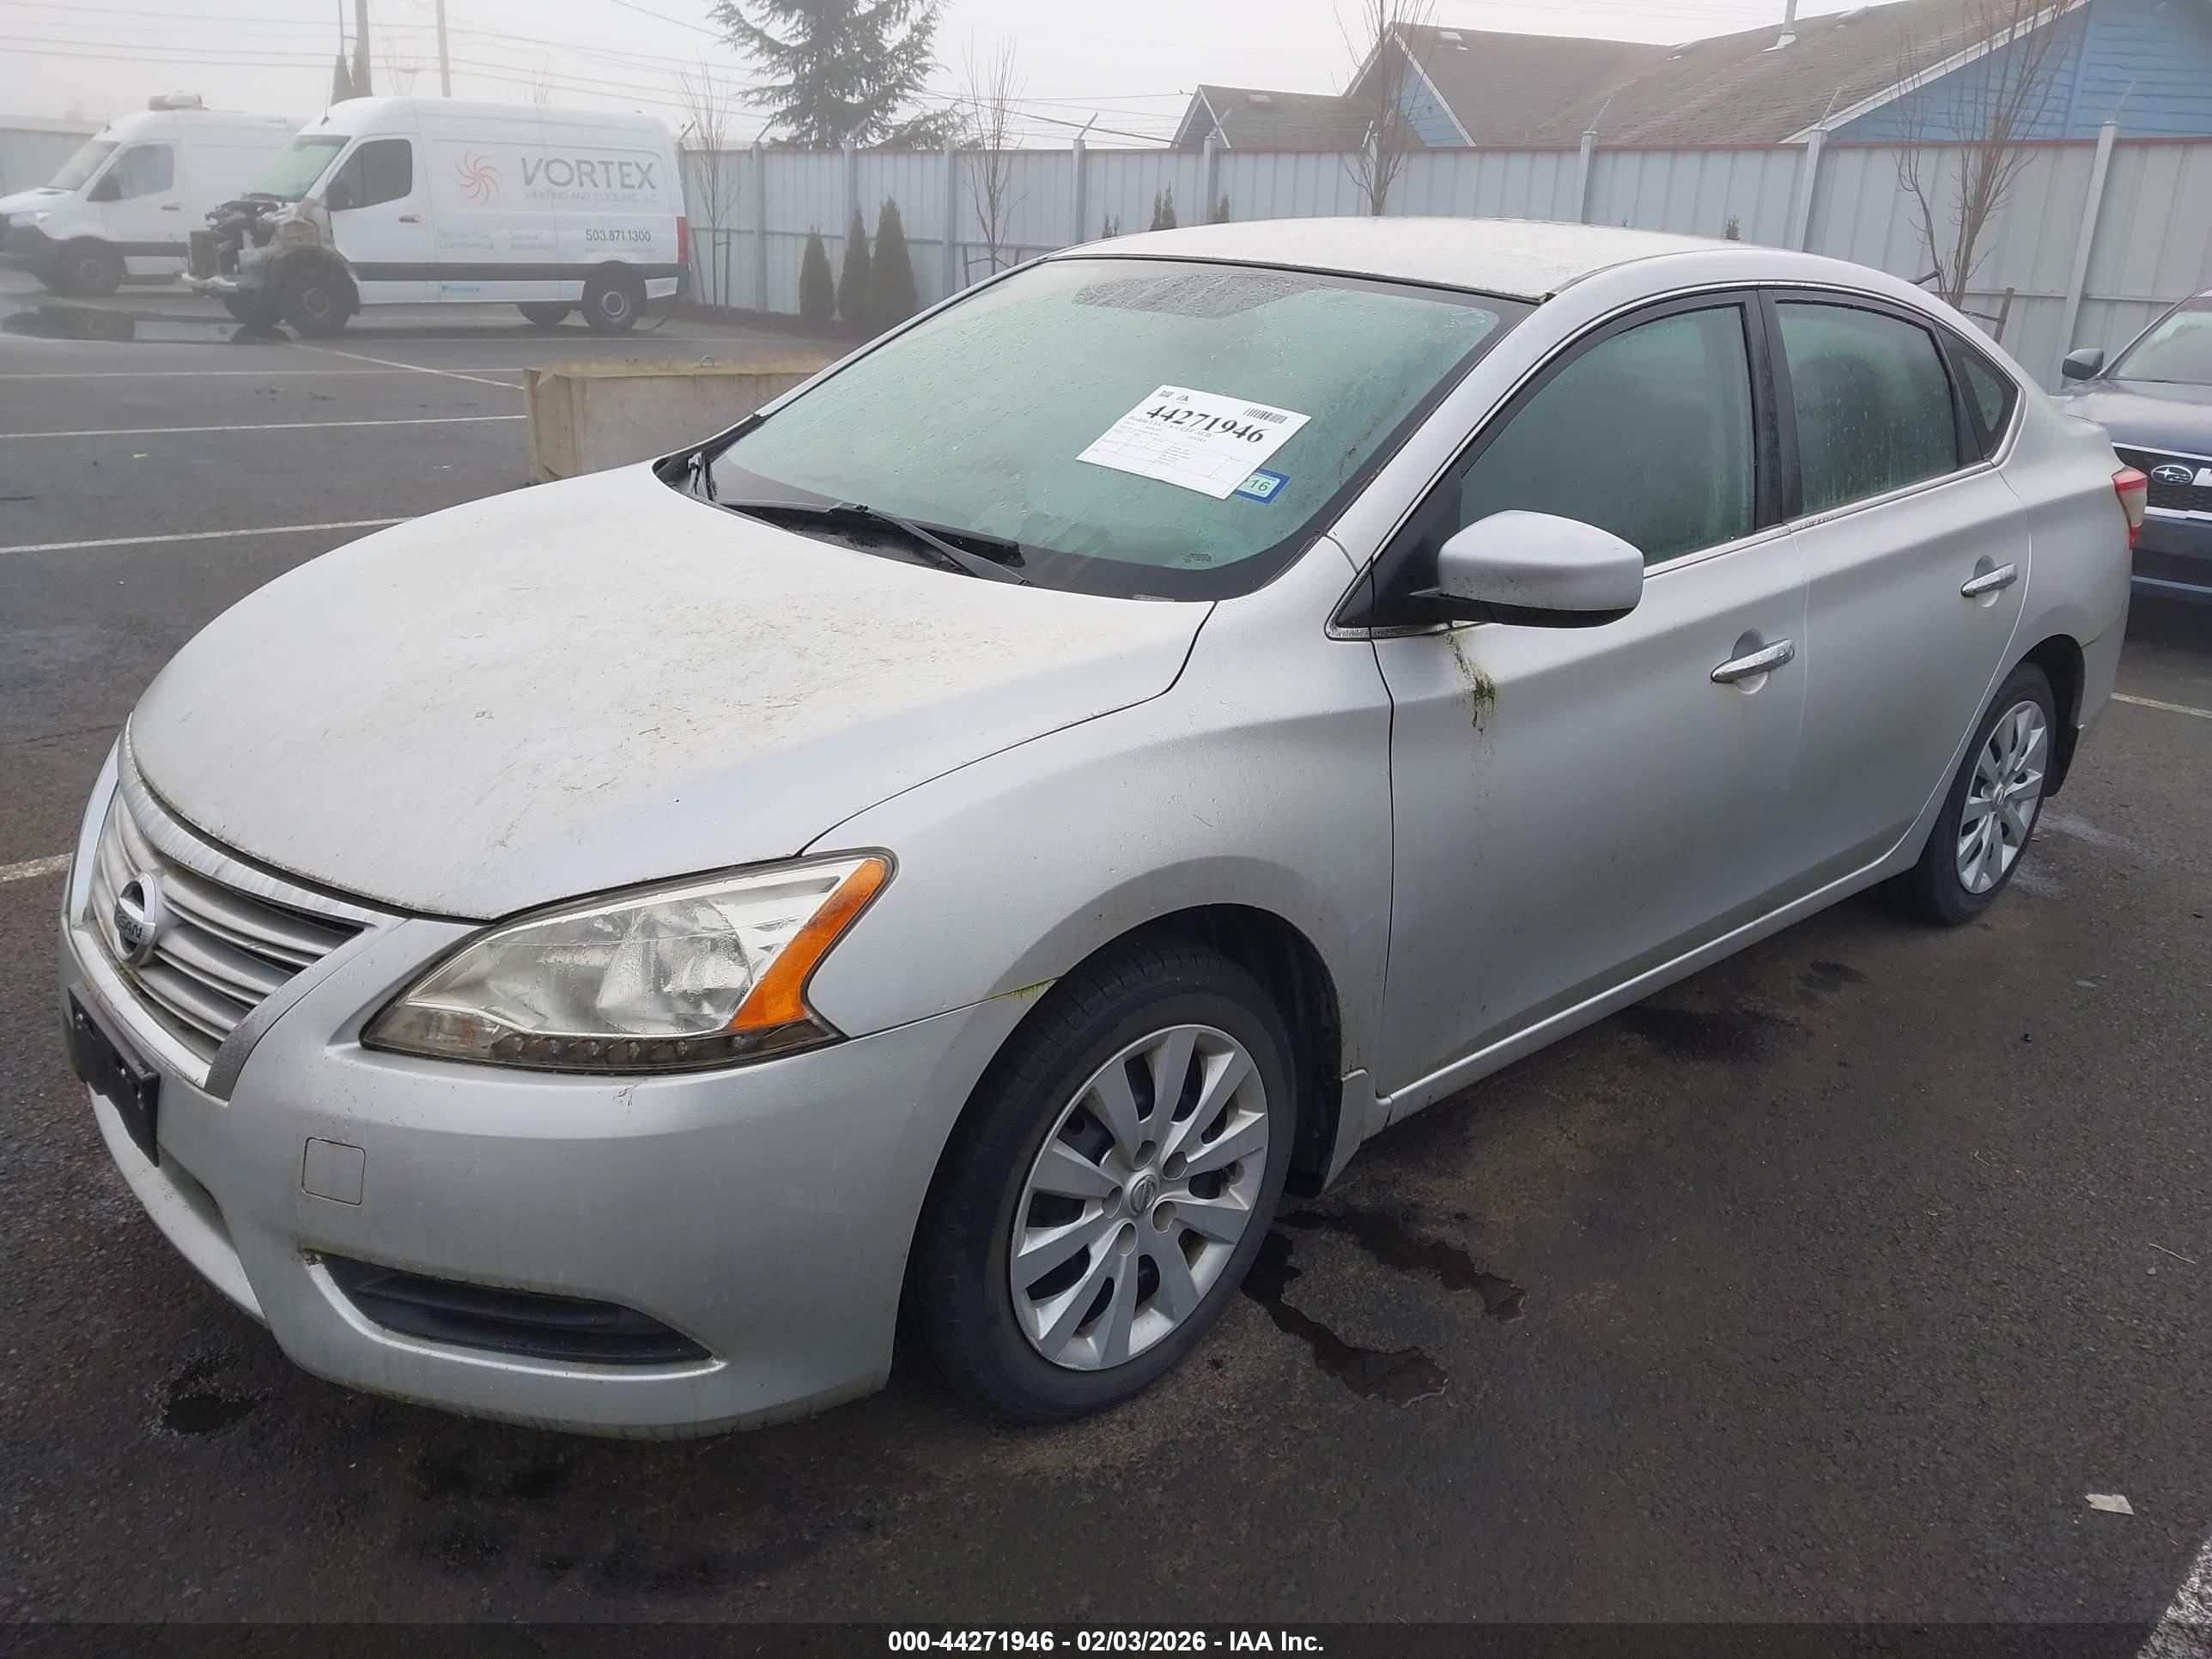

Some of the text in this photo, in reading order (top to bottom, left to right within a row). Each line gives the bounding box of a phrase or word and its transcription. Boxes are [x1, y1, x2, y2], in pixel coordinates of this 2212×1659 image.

[521, 157, 656, 190] VORTEX
[570, 191, 592, 201] AND
[586, 229, 651, 242] 503.871.1300
[1146, 405, 1270, 443] 44271946
[1250, 479, 1271, 492] 16
